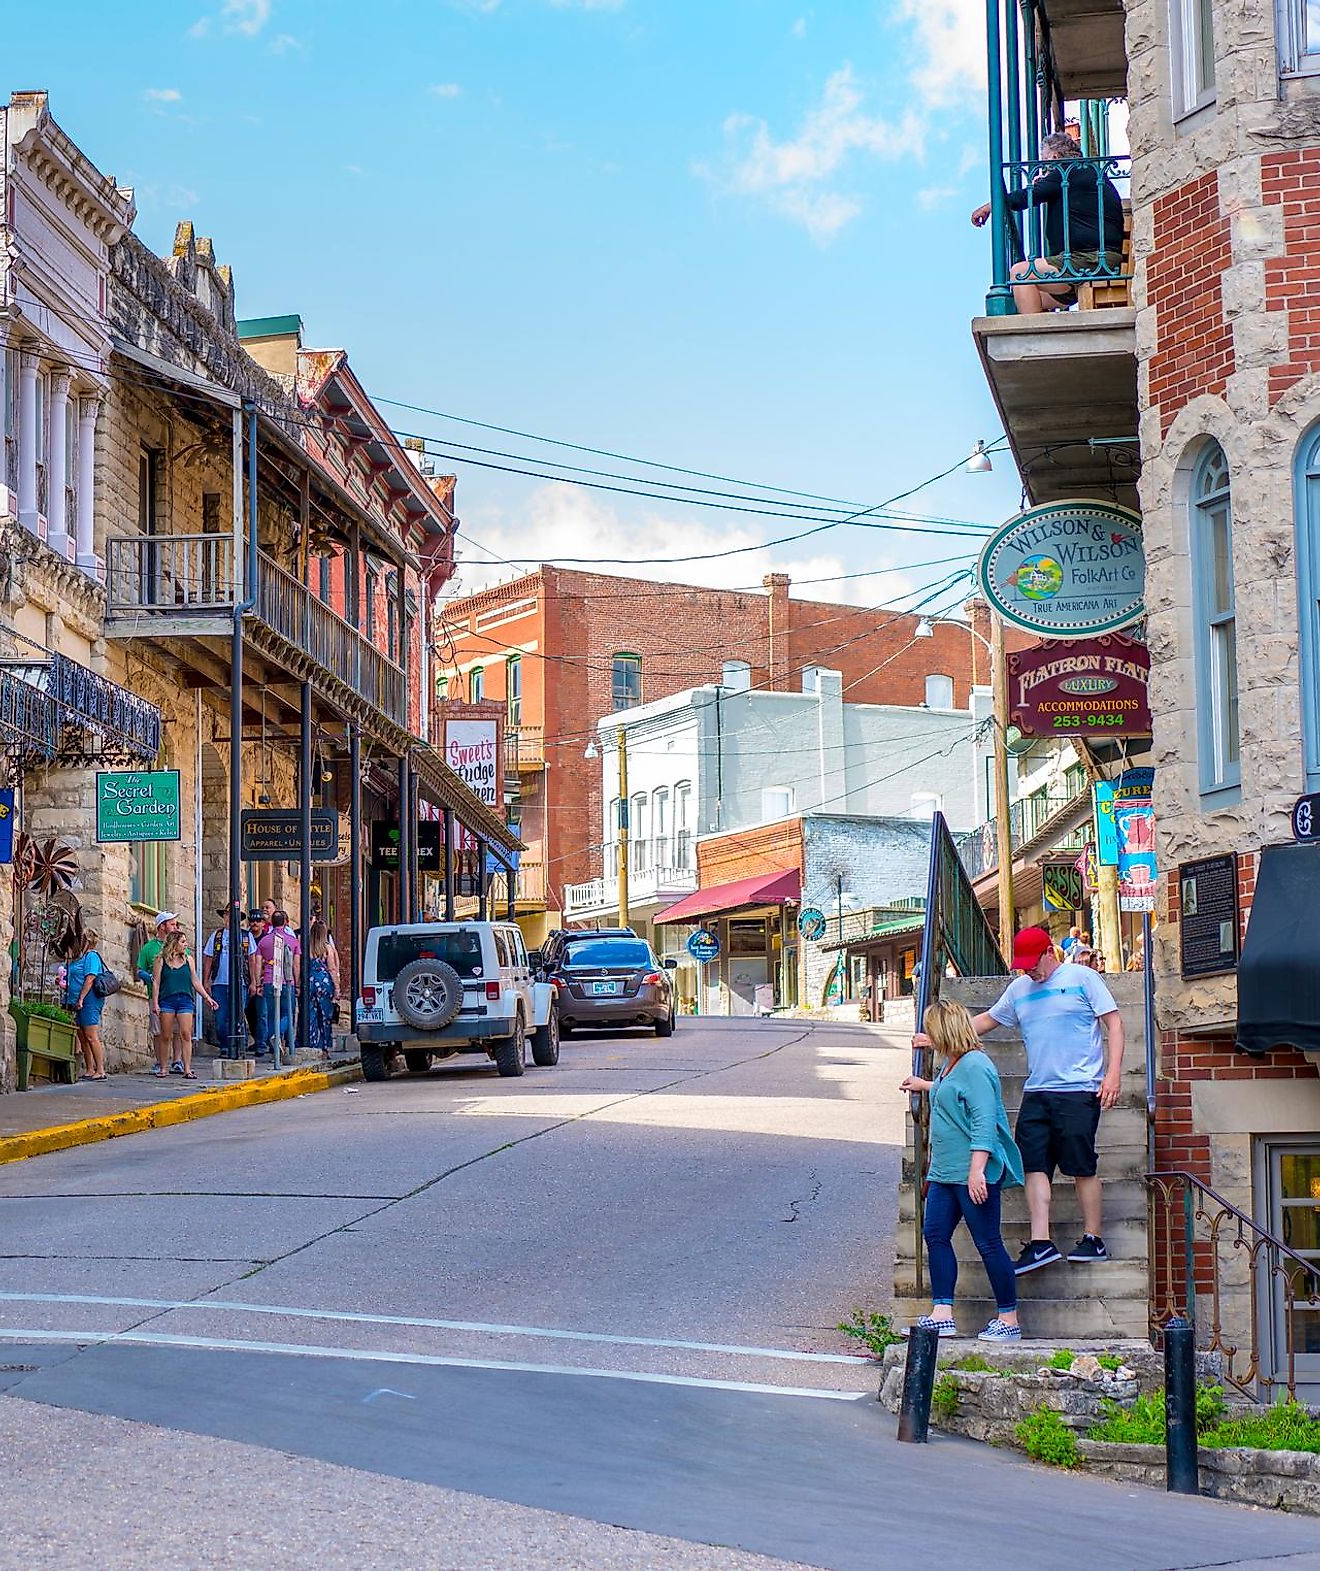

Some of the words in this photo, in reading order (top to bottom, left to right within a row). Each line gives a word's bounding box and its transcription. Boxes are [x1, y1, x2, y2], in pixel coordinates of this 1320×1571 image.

[1006, 518, 1091, 555] WILSON
[1091, 525, 1106, 542] &
[1054, 538, 1141, 565] WILSON
[1032, 602, 1053, 613] TRUE
[1056, 600, 1100, 612] AMERICANA
[1103, 599, 1118, 609] ART
[1065, 679, 1112, 691] LUXURY
[1037, 700, 1139, 713] ACCOMMODATIONS
[1053, 714, 1125, 728] 253-9434
[102, 781, 154, 800] Secret
[116, 799, 176, 819] Garden
[247, 823, 281, 834] HOUSE
[284, 824, 298, 834] OF
[379, 847, 398, 856] TEE
